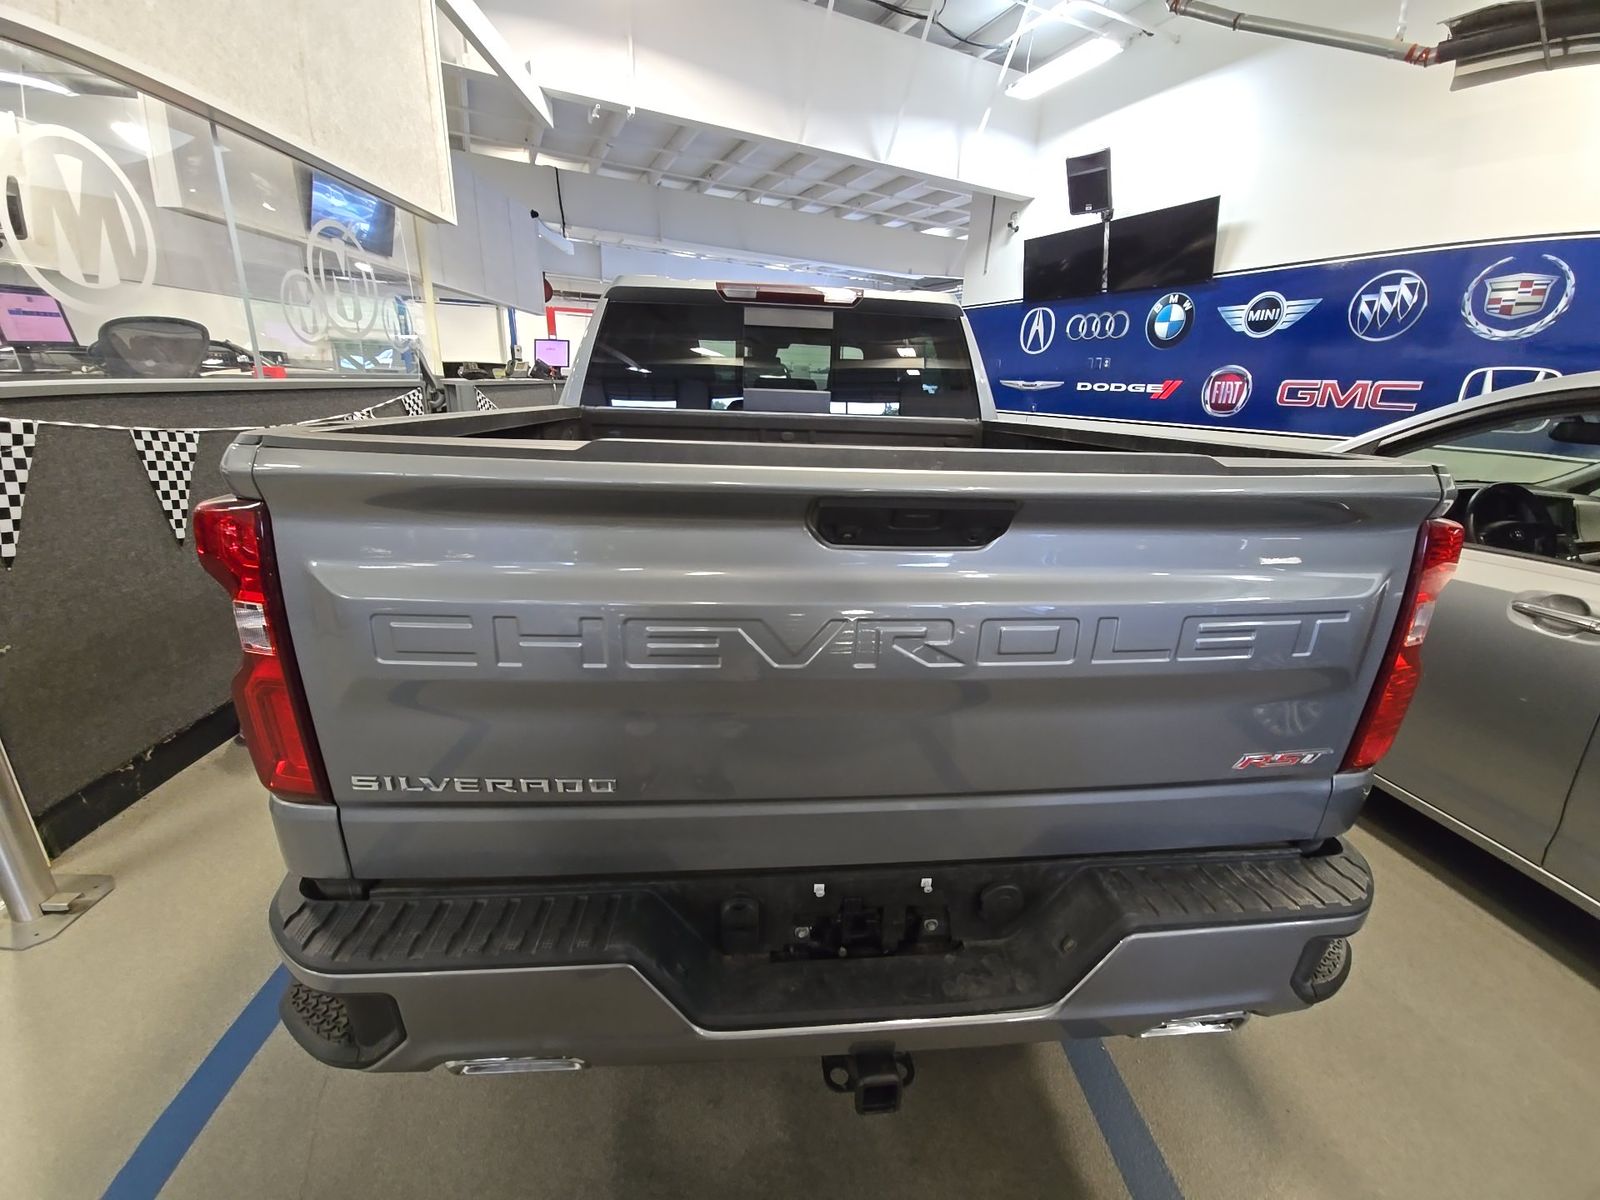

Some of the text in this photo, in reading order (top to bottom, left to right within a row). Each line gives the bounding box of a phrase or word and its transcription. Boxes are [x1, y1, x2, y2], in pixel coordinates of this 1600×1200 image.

[1153, 294, 1193, 314] BMW
[1248, 307, 1281, 322] MINI
[1076, 381, 1164, 394] DODGE
[1211, 380, 1244, 404] FIAT
[1276, 379, 1424, 412] GMC
[369, 610, 1352, 669] CHEVROLET
[350, 775, 618, 794] SILVERADO
